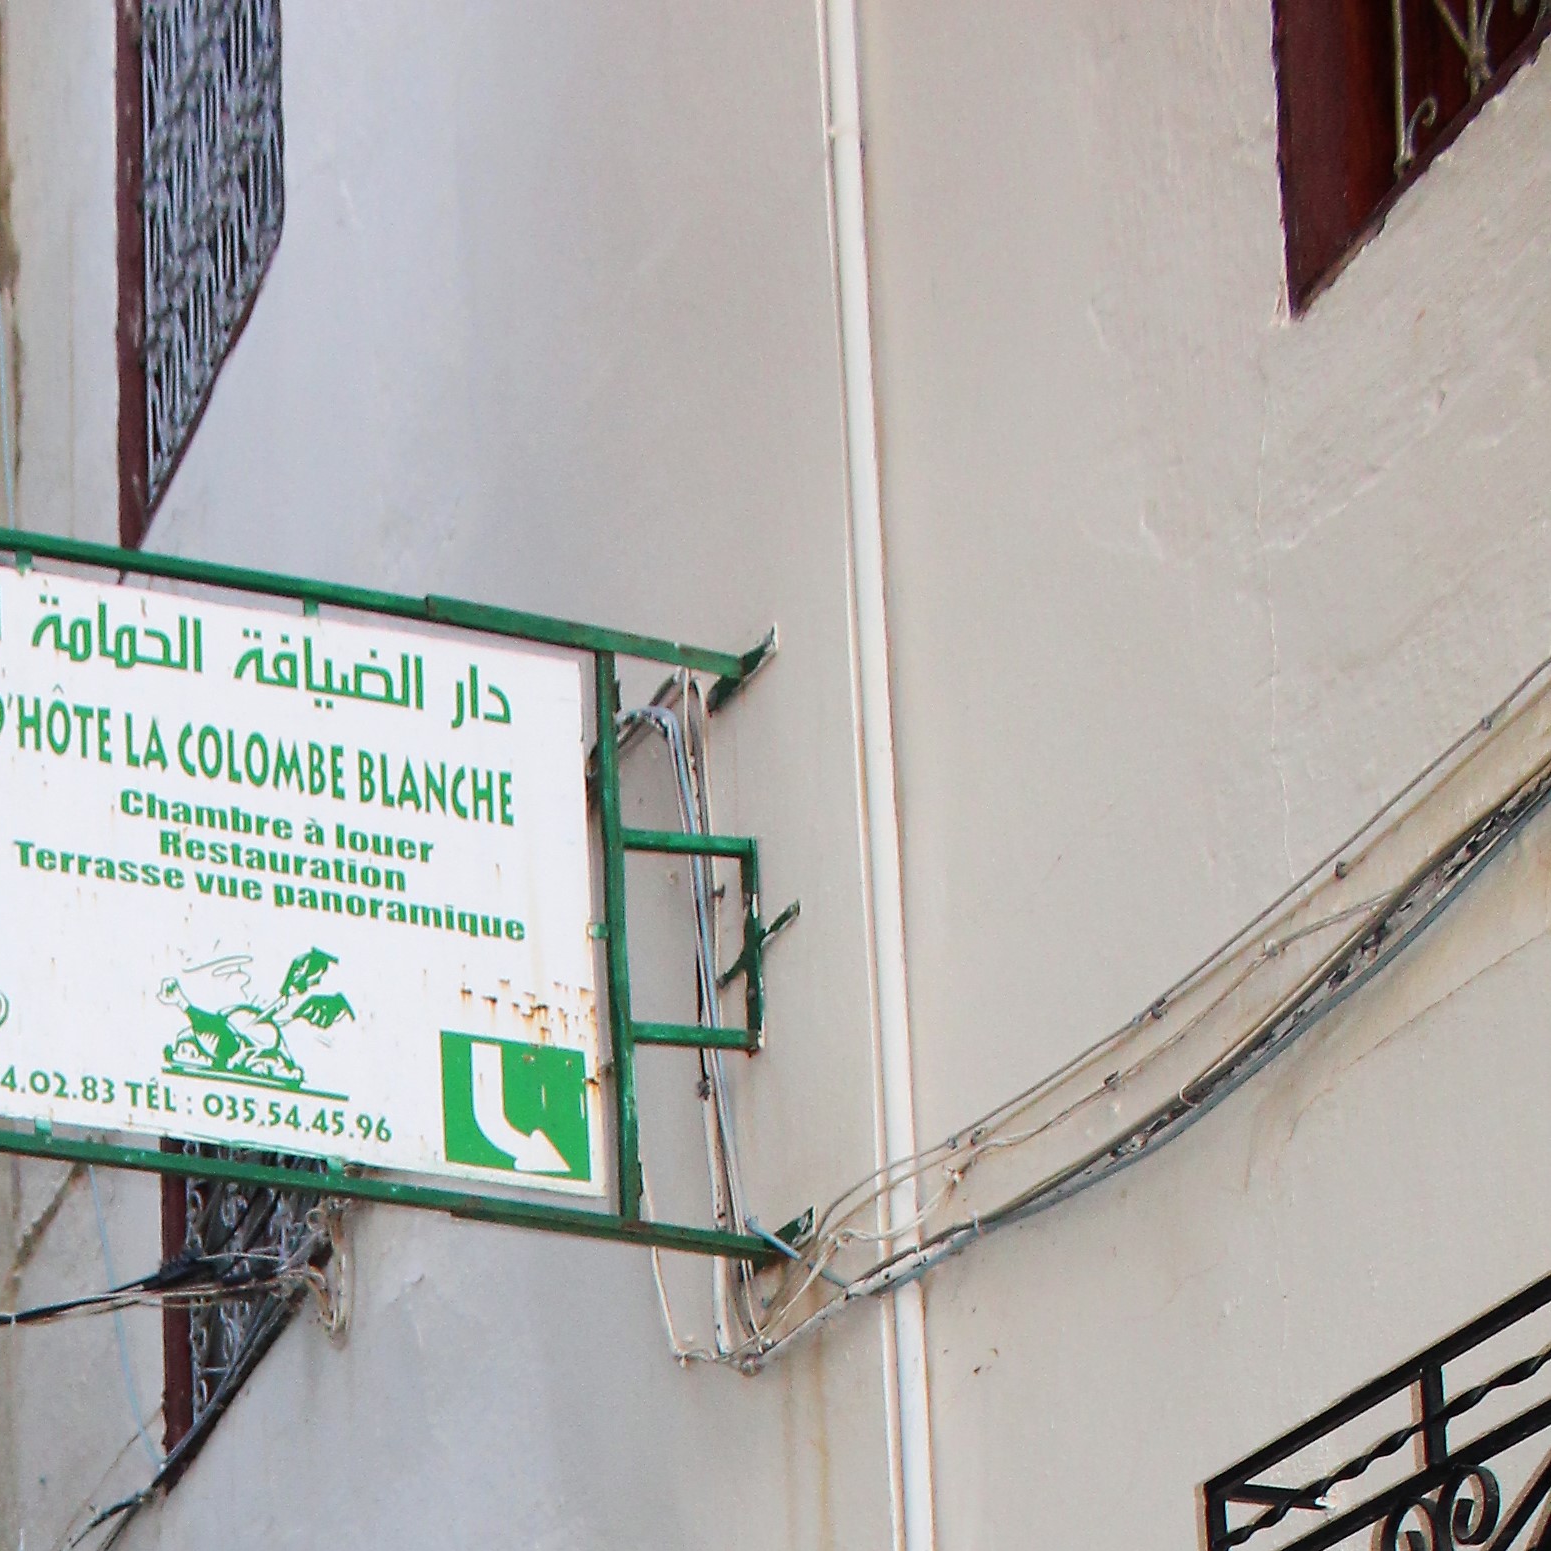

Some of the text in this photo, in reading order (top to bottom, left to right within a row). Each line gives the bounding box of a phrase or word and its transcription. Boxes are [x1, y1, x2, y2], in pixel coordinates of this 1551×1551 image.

[31, 593, 203, 673] الحمامة
[233, 628, 424, 710] الضيافة
[451, 664, 511, 729] دار
[125, 712, 168, 771] LA
[178, 721, 346, 800] COLOMBE
[358, 749, 514, 826] BLANCHE
[120, 789, 435, 863] Chambre à louer
[159, 830, 407, 892] Restauration
[14, 840, 525, 941] Terrasse vue panoramique
[125, 1077, 177, 1112] TÉL
